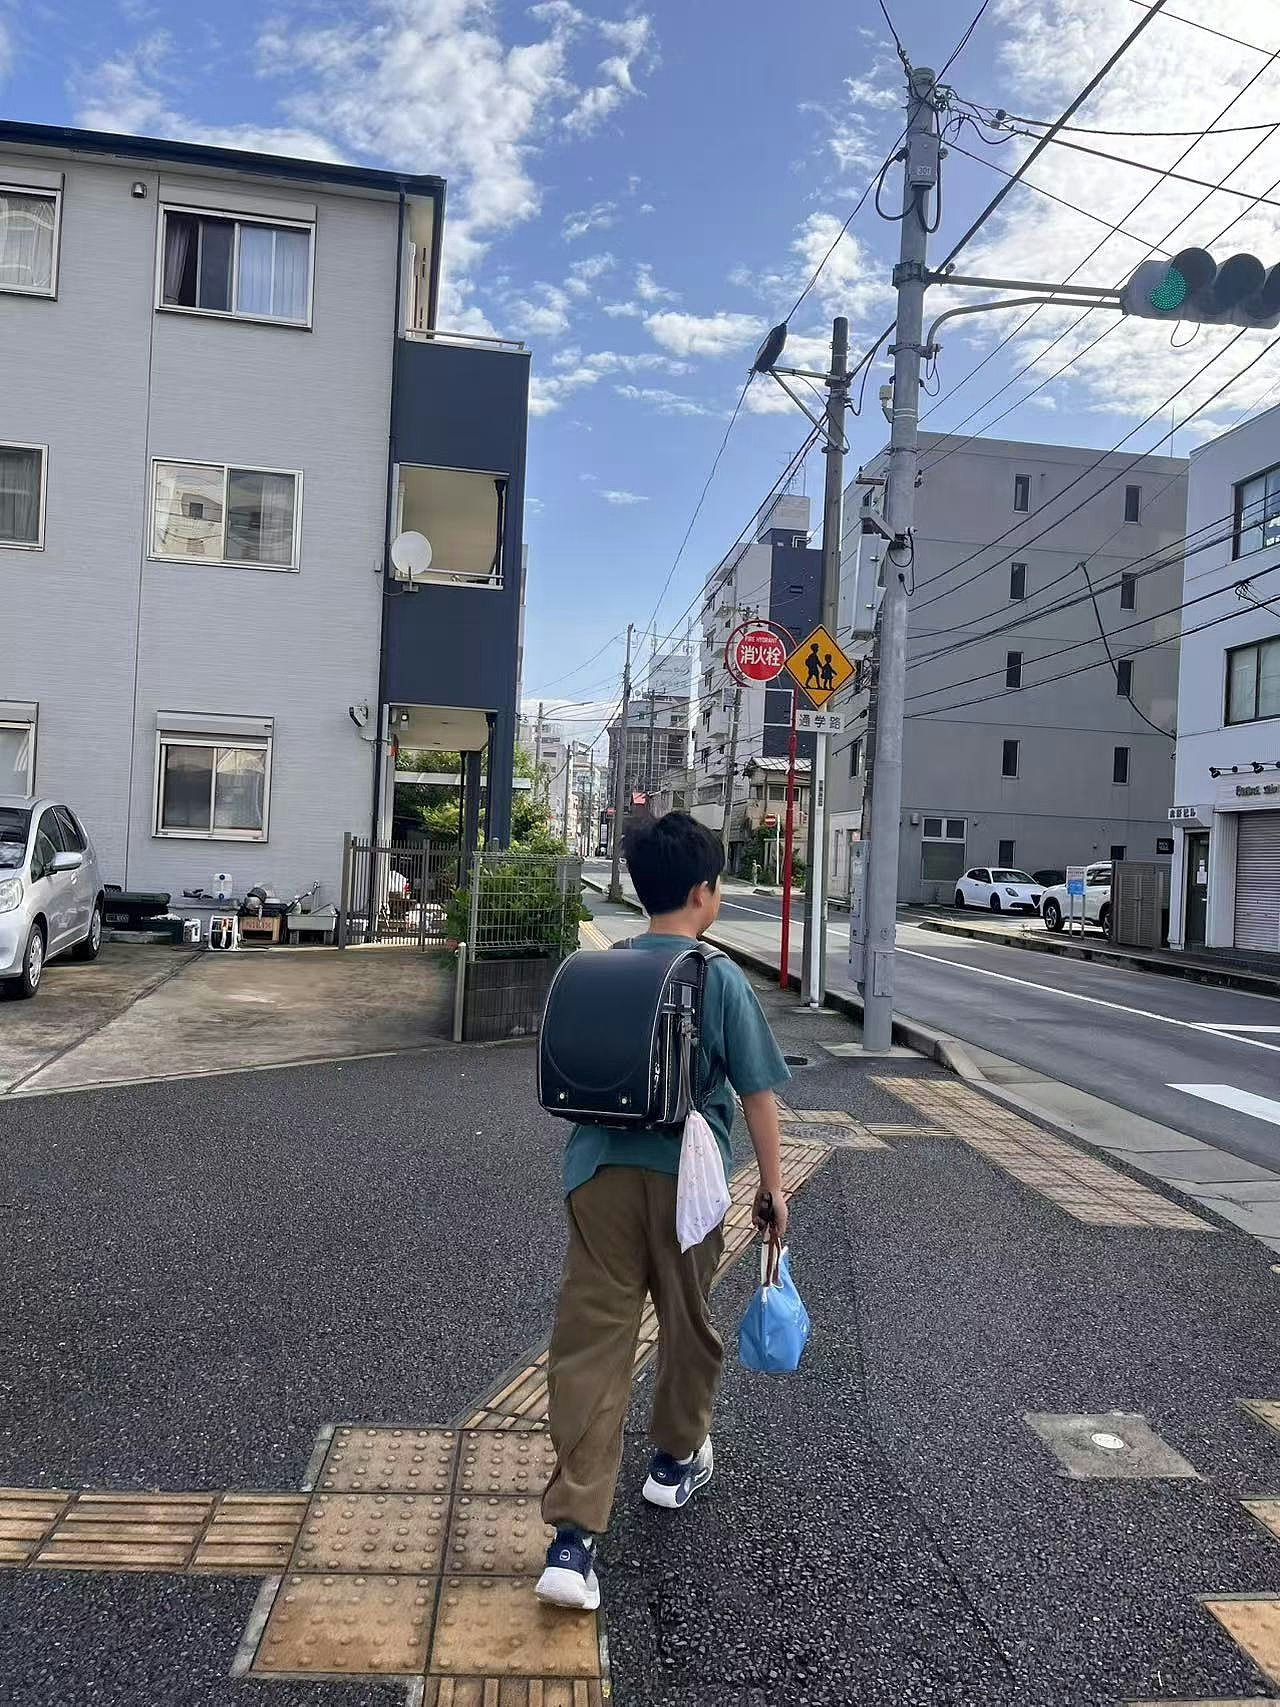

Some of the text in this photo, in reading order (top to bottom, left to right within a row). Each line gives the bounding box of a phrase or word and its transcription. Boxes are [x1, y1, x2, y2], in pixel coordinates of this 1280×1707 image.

[740, 645, 781, 666] 消火栓
[799, 714, 841, 729] 通学路
